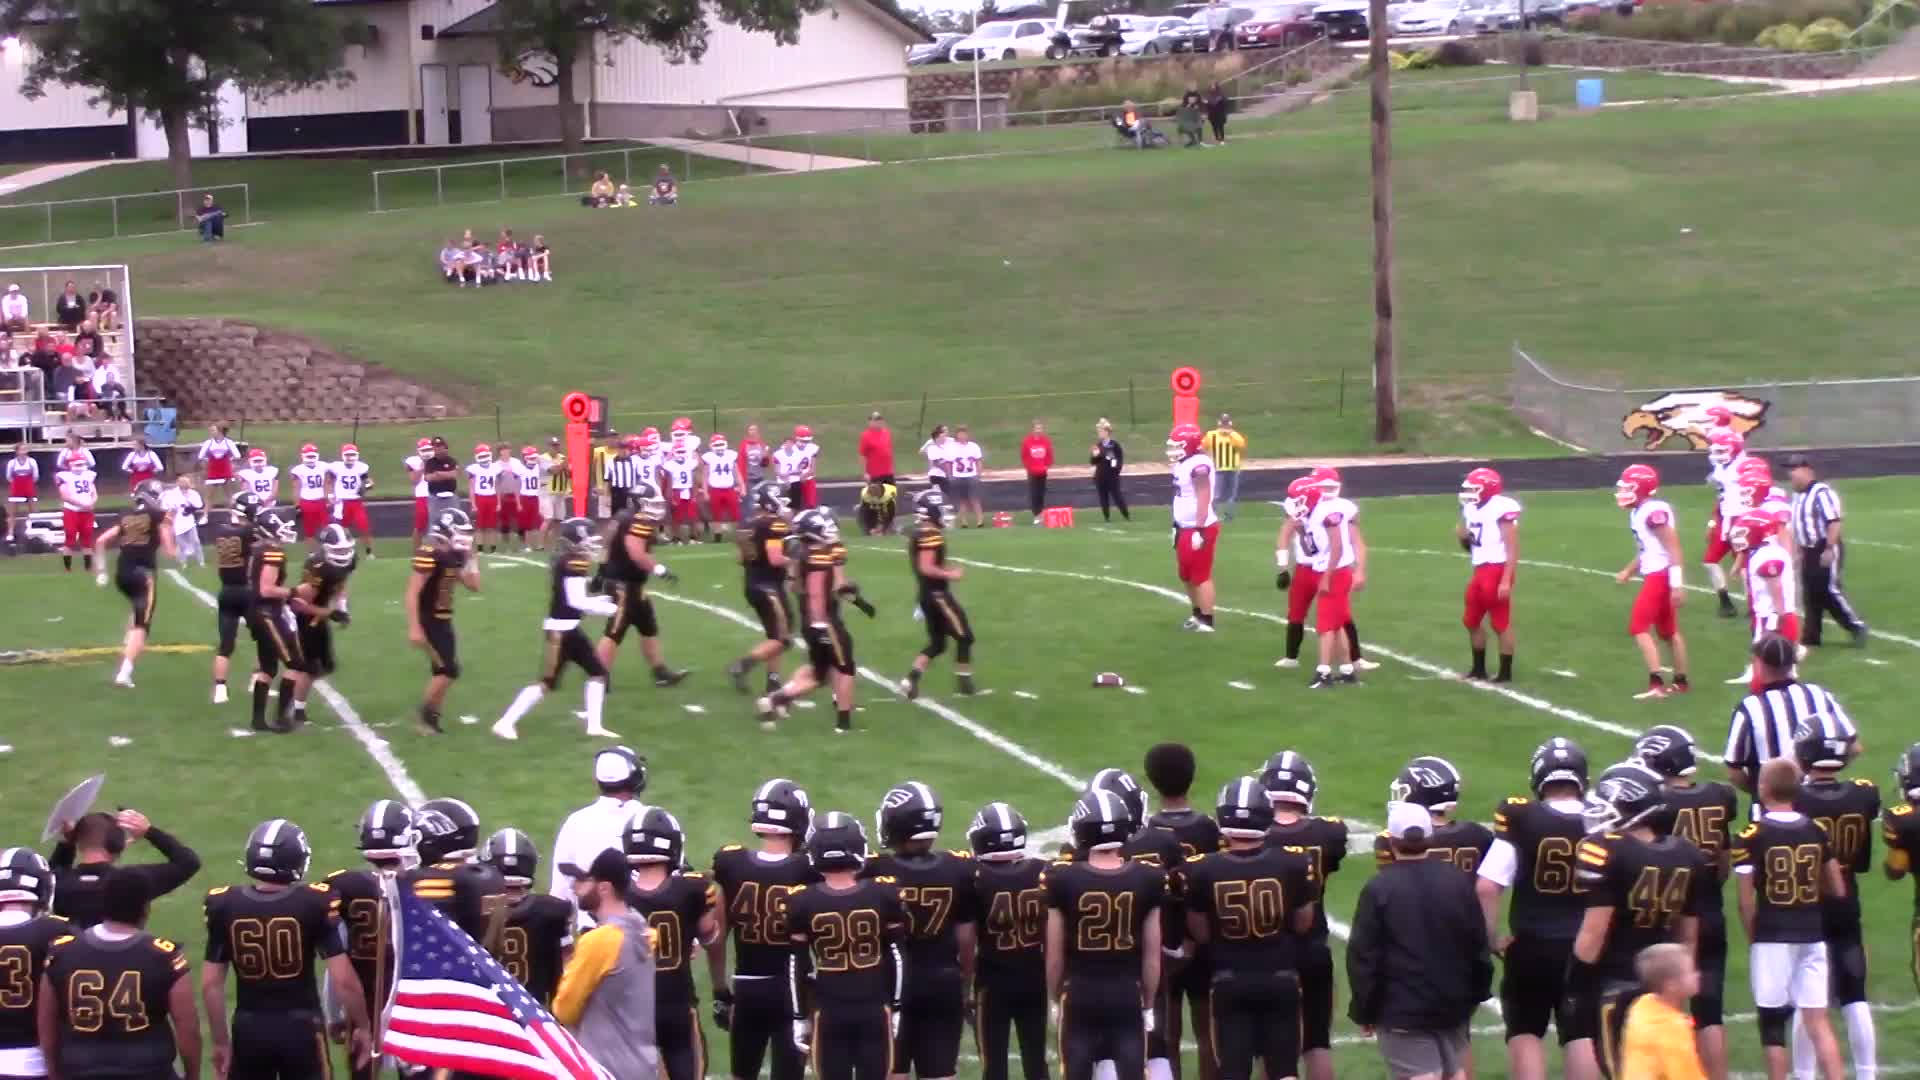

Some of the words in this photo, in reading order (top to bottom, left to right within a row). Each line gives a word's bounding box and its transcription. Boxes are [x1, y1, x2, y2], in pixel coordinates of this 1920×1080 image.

[254, 479, 271, 493] 62
[307, 475, 322, 489] 50
[341, 475, 357, 490] 52
[479, 475, 494, 490] 24
[525, 476, 539, 490] 10
[679, 470, 688, 485] 9
[714, 463, 730, 476] 44
[1765, 843, 1823, 905] 83
[1213, 877, 1284, 940] 50
[1628, 865, 1691, 928] 44
[1077, 891, 1135, 951] 21
[231, 916, 304, 979] 60
[811, 908, 882, 972] 28
[68, 969, 150, 1032] 64
